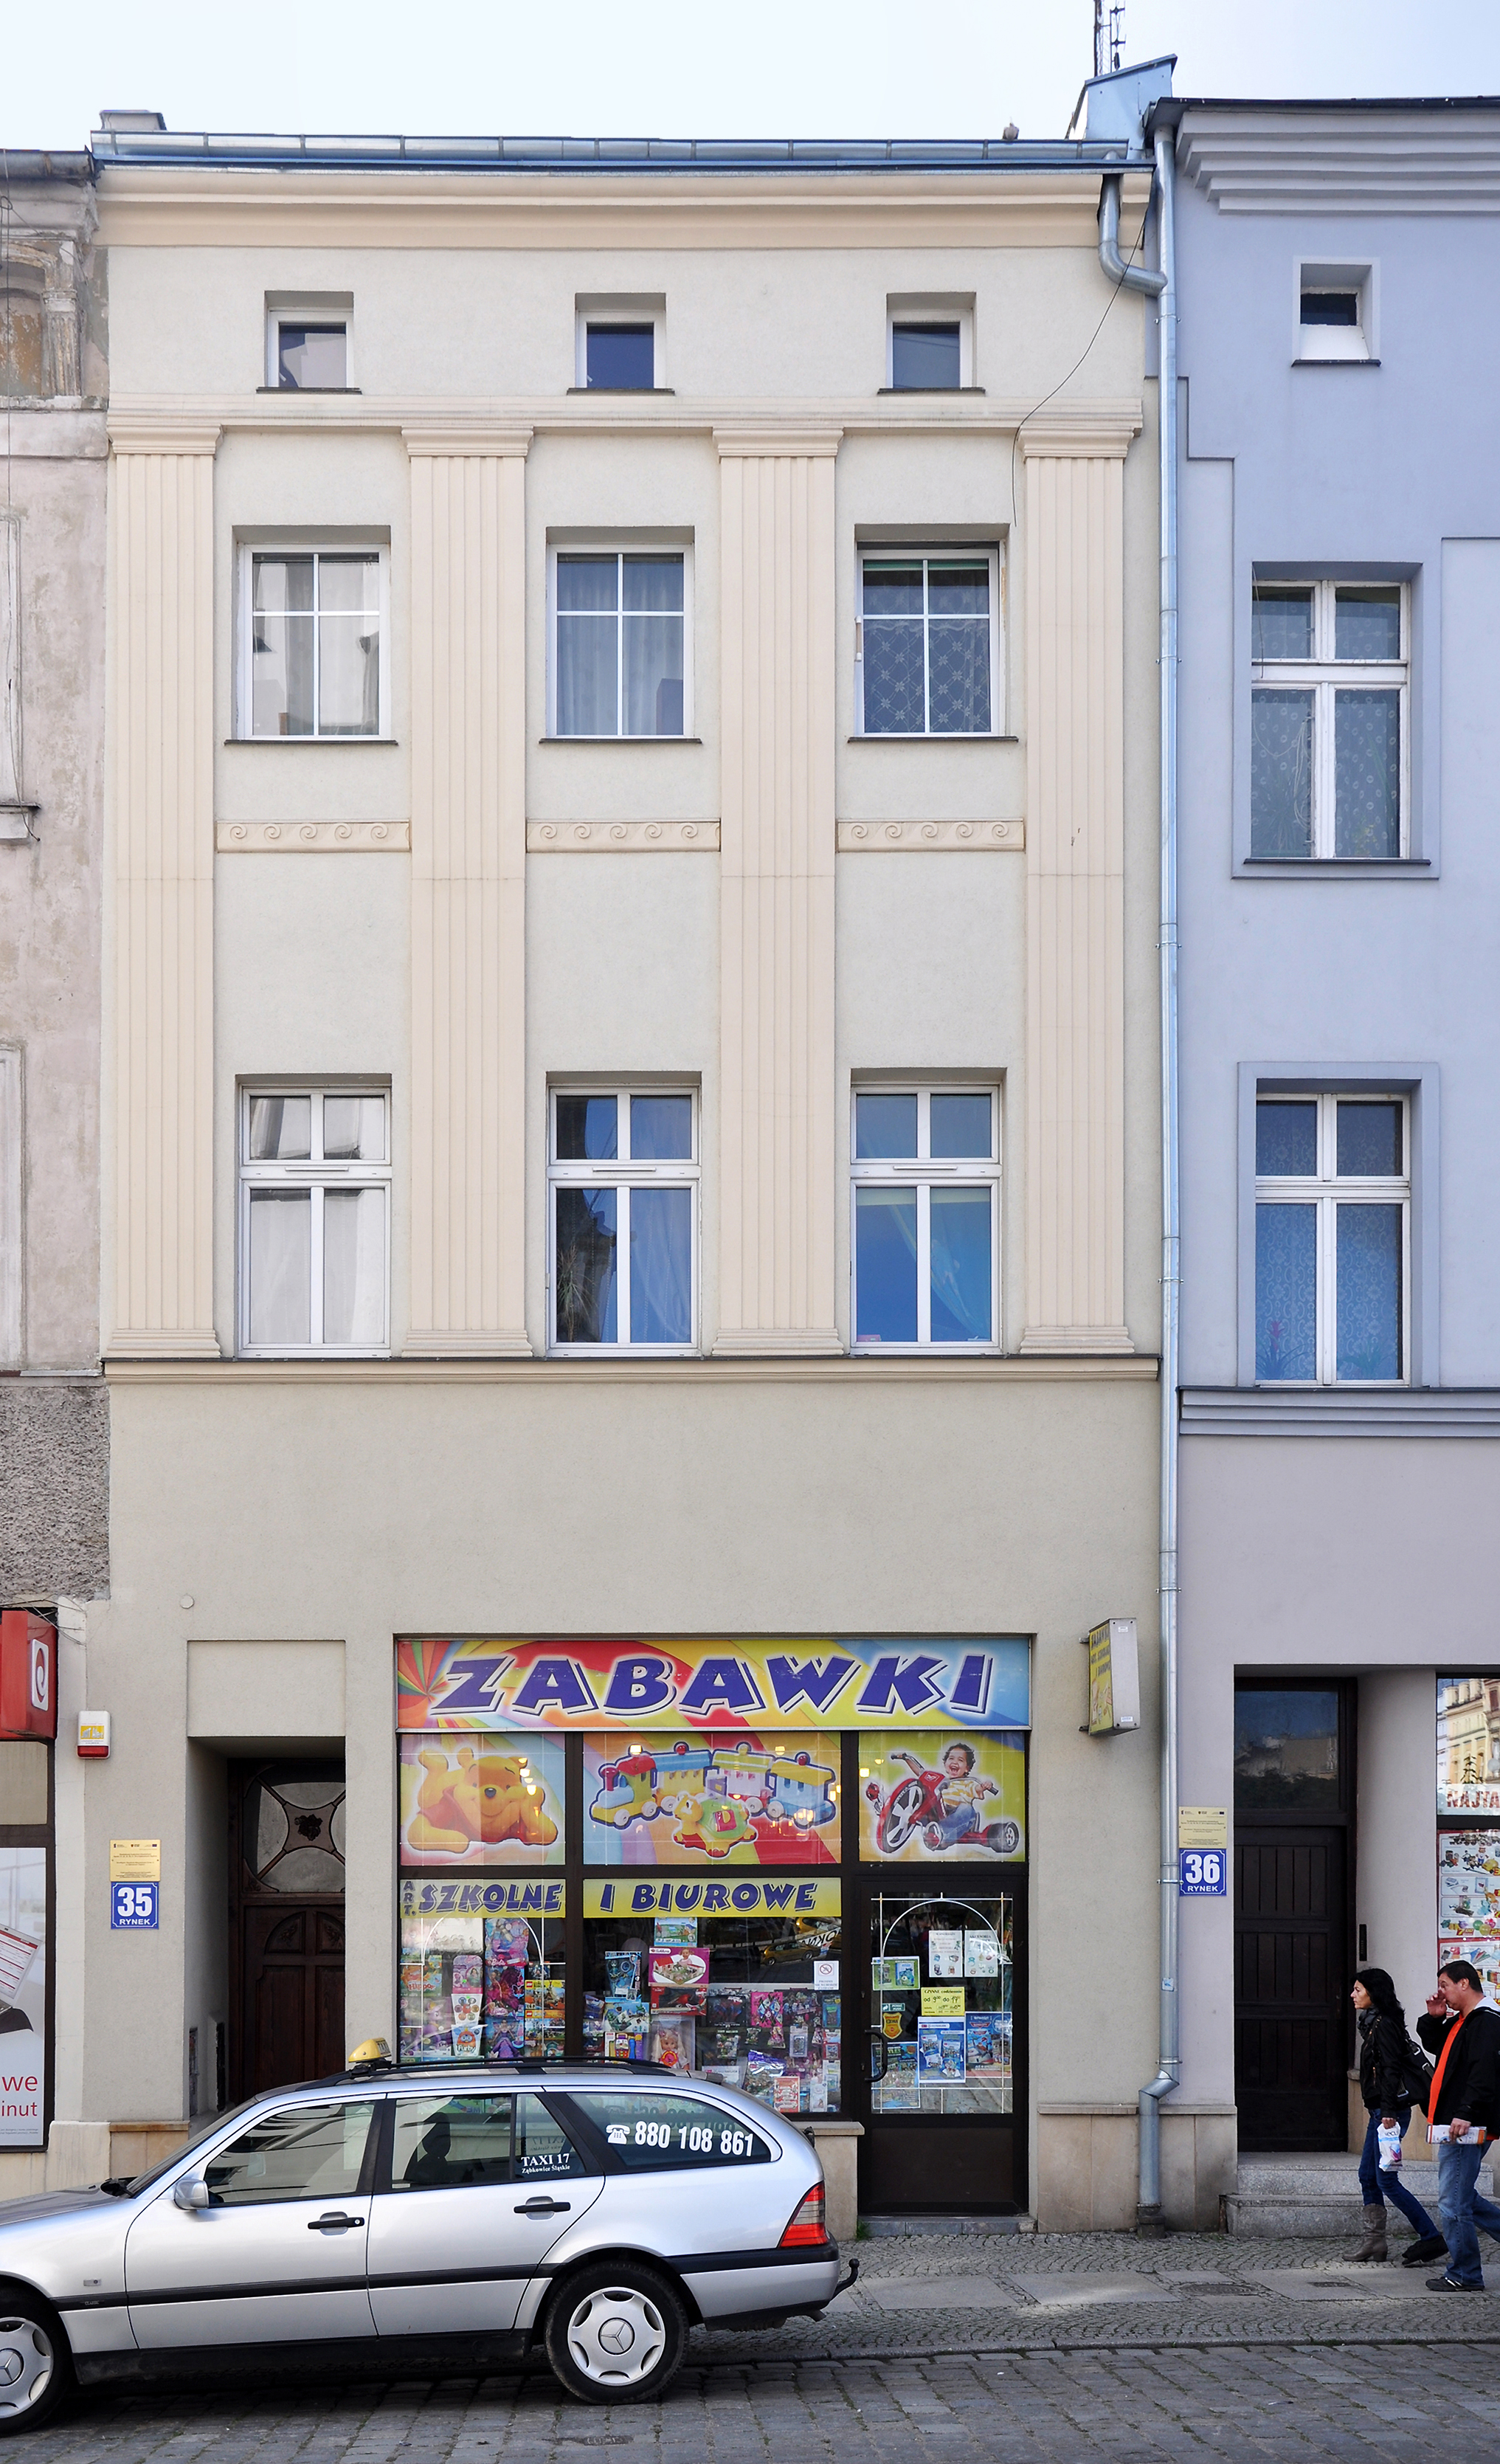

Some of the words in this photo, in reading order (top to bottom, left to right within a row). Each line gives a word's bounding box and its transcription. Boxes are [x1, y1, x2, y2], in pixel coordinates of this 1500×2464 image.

[430, 1654, 995, 1716] ZABAWKI
[1185, 1854, 1220, 1884] 36
[117, 1887, 153, 1917] 35
[418, 1883, 564, 1913] SZKOLNE
[600, 1883, 615, 1913] I
[631, 1882, 818, 1913] BIUROWE
[1, 2076, 38, 2091] we
[1, 2100, 38, 2116] inut
[635, 2121, 671, 2149] 880
[678, 2126, 713, 2153] 108
[720, 2130, 753, 2157] 861
[521, 2155, 553, 2167] TAXI
[557, 2153, 570, 2164] 17
